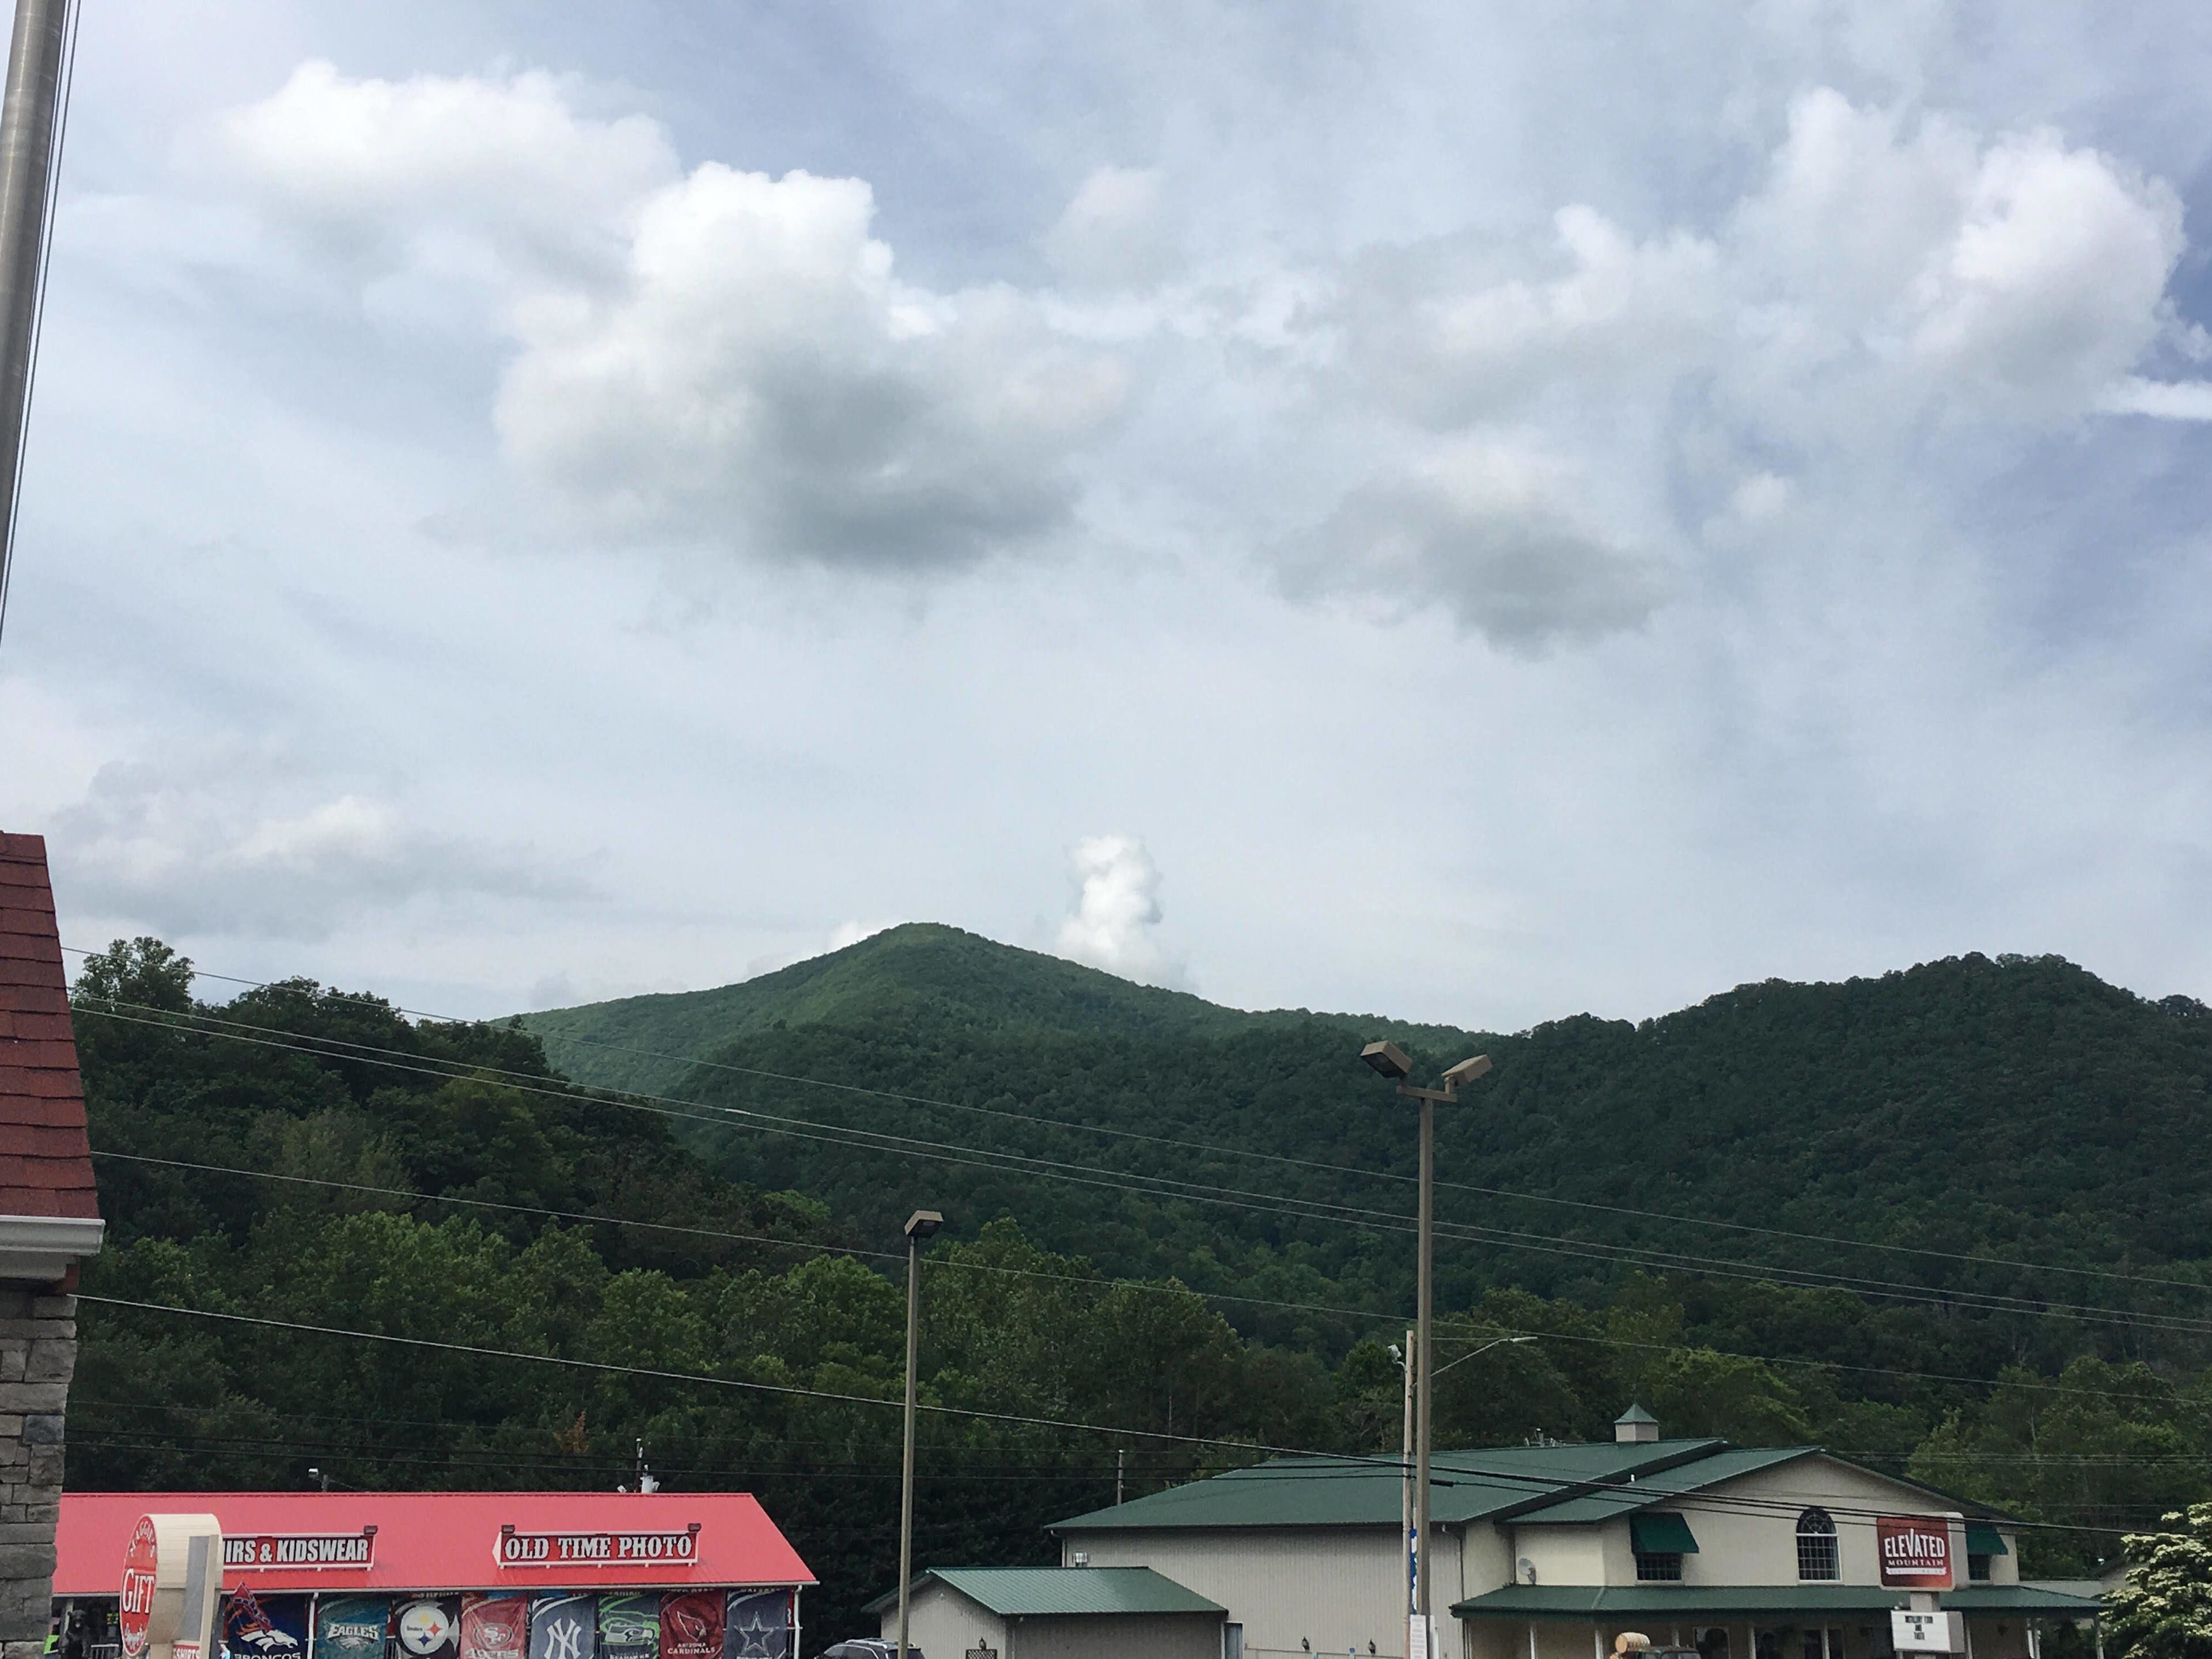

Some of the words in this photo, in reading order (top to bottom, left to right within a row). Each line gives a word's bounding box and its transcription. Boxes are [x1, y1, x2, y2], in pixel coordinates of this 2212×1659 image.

[259, 1543, 273, 1563] &
[276, 1539, 369, 1562] KIDSWEAR
[505, 1537, 550, 1560] OLD
[558, 1536, 611, 1559] TIME
[618, 1535, 692, 1558] PHOTO
[1884, 1528, 1945, 1558] ELEVATED
[122, 1568, 155, 1613] GIFT
[327, 1623, 379, 1640] EAGLES
[667, 1646, 715, 1655] CARDINALS
